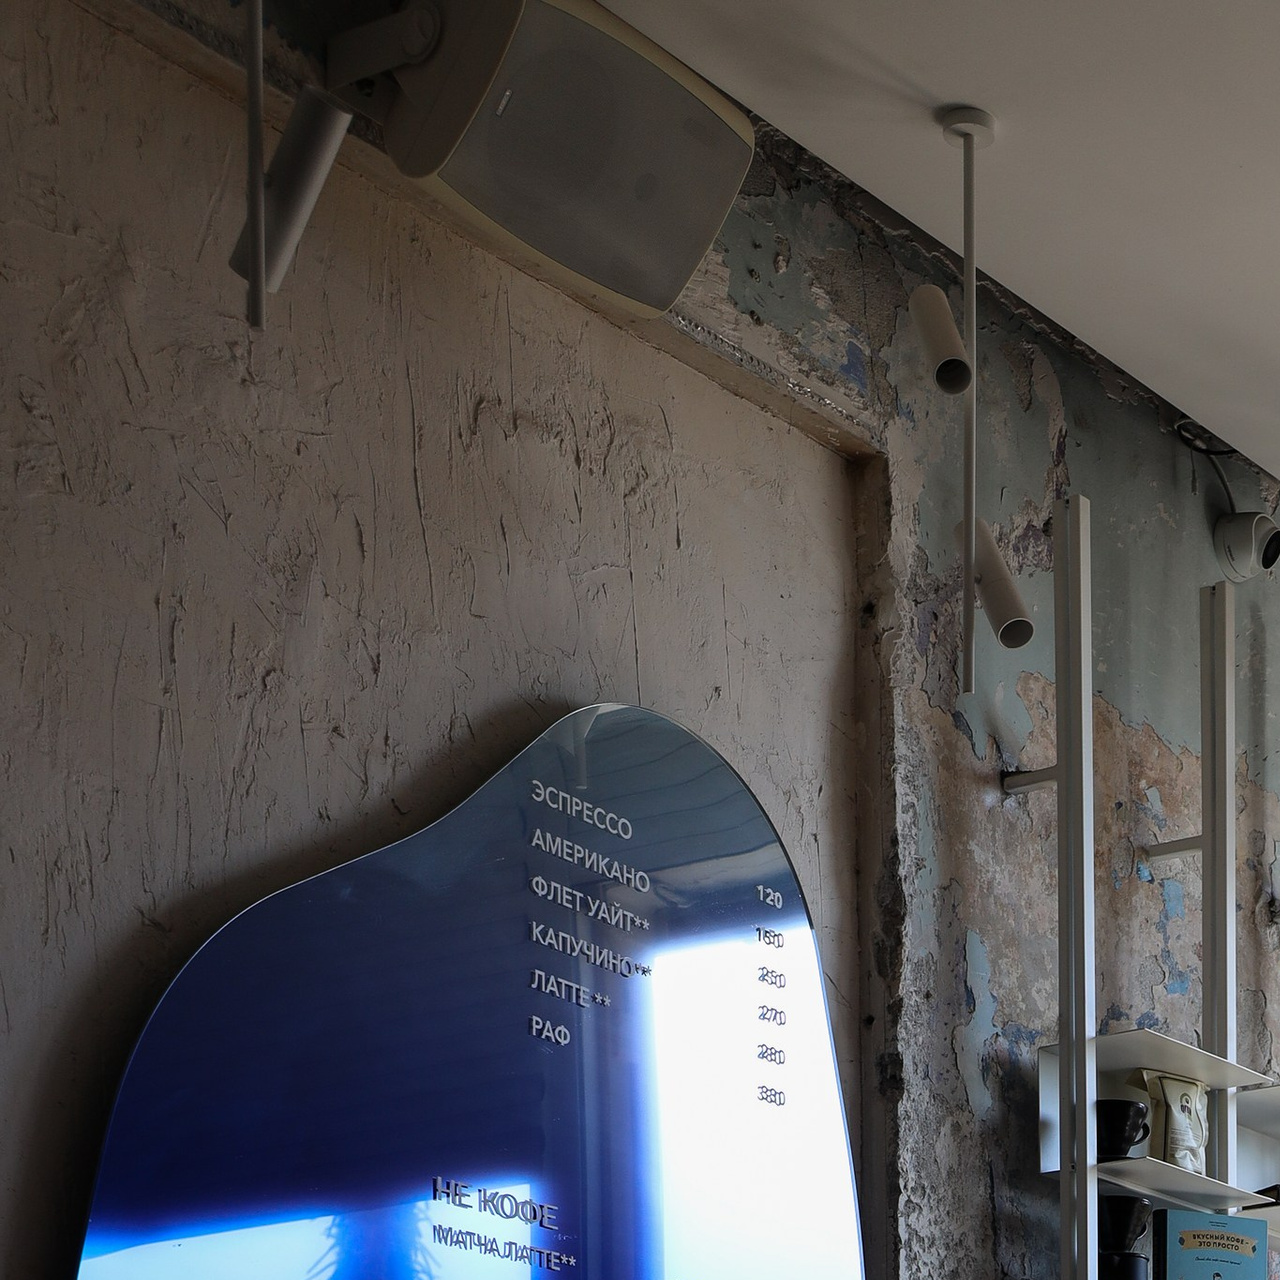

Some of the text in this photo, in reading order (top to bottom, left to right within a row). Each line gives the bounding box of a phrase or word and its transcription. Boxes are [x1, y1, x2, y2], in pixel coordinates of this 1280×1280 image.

[532, 780, 633, 840] ЭСПРЕССО
[531, 828, 650, 893] АМЕРИКАНО
[532, 876, 584, 912] ФЛЕТ
[756, 885, 783, 910] 120
[529, 1014, 571, 1046] РАФ
[757, 1005, 786, 1026] 270
[757, 1043, 786, 1065] 280
[432, 1176, 559, 1231] НЕ КОФЕ
[433, 1224, 499, 1257] МАТЧА
[1193, 1233, 1225, 1241] ВКУСНЫЙ
[1226, 1236, 1244, 1245] КОФЕ
[1212, 1241, 1240, 1251] ПРОСТО
